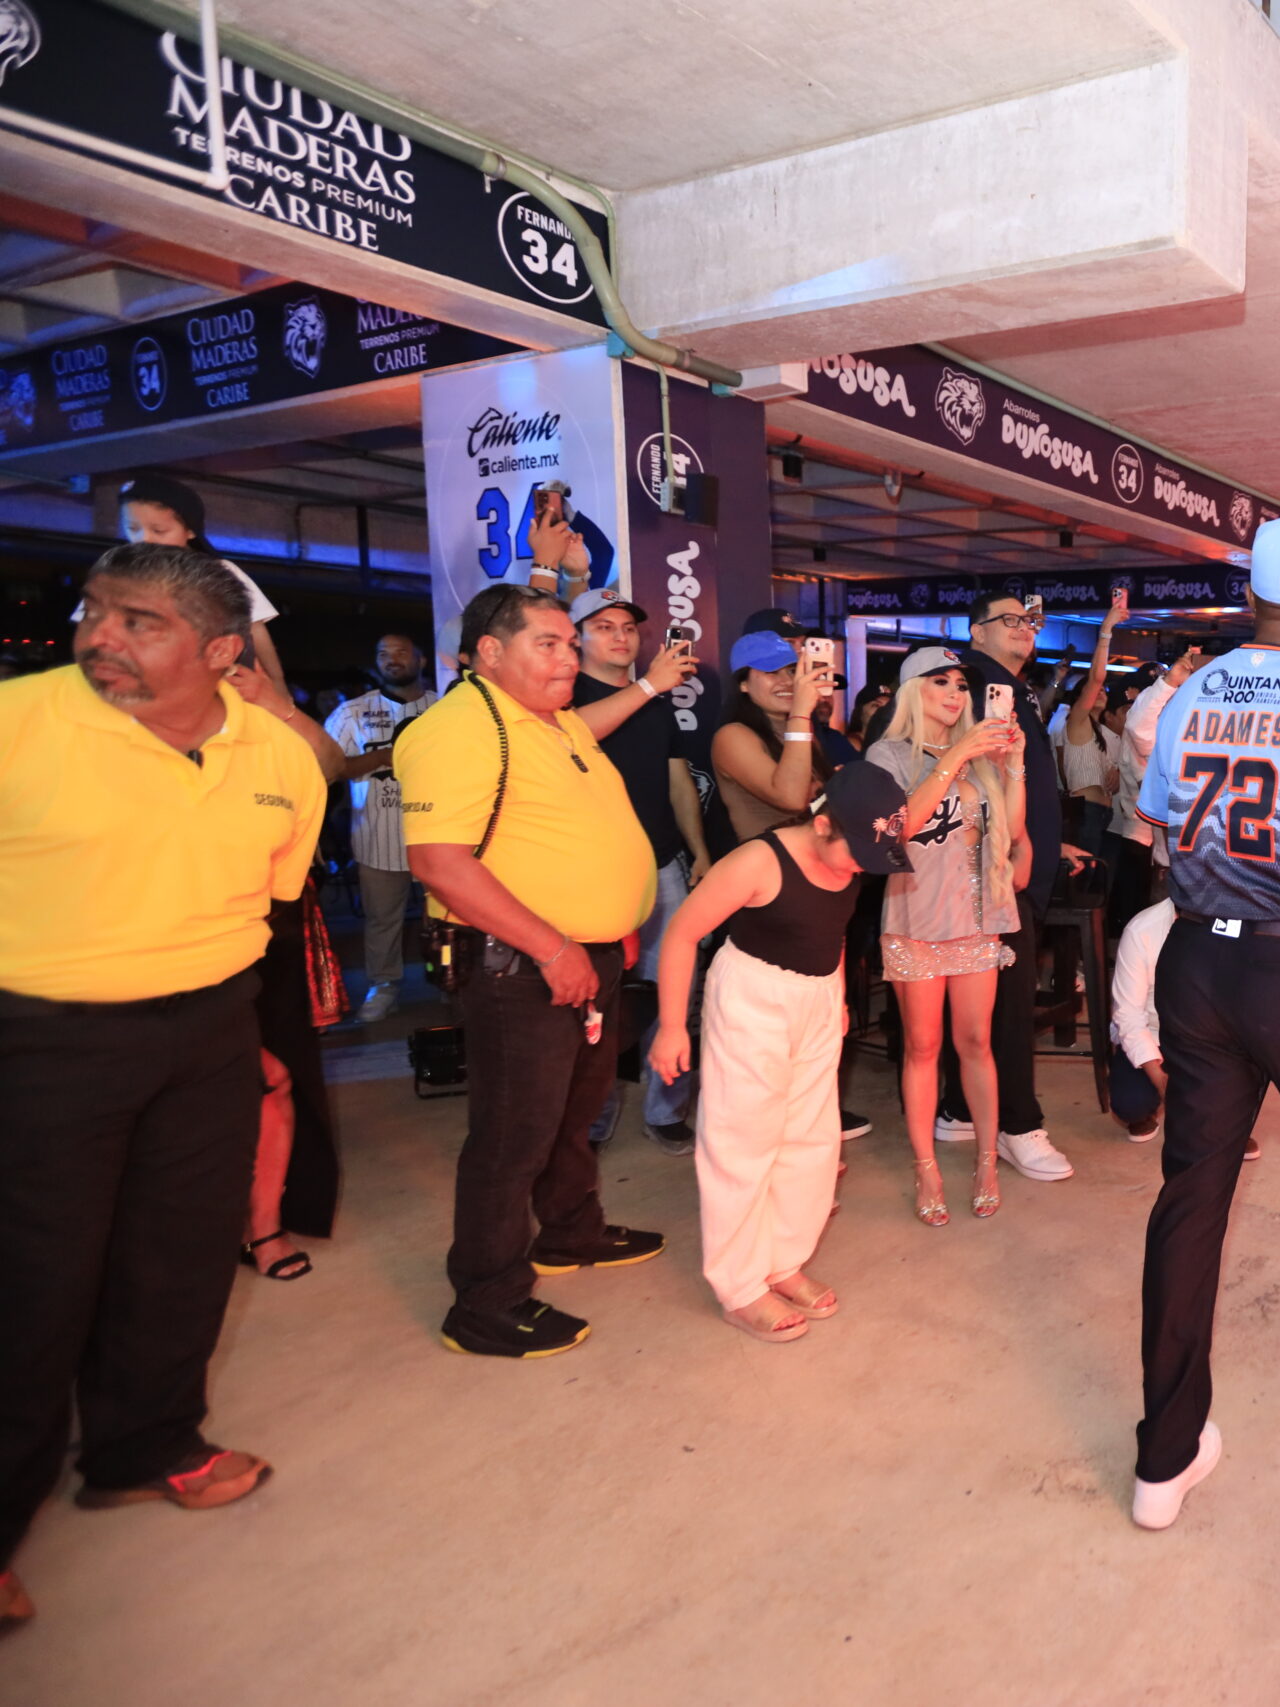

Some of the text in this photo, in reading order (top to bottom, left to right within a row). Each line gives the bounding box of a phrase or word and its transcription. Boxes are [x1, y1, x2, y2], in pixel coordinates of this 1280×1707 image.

[165, 74, 418, 205] MADERAS
[173, 126, 414, 229] TERENOS PREMIUM
[224, 173, 380, 252] CARIBE
[517, 204, 576, 242] FERNAND
[521, 228, 578, 288] 34
[186, 308, 256, 346] CIUDAD
[401, 323, 441, 340] PREMIUM
[52, 344, 108, 376] CIUDAD
[190, 336, 259, 372] MADERAS
[374, 343, 428, 373] CARIBE
[138, 364, 161, 396] 34
[206, 382, 250, 408] CARIBE
[806, 353, 916, 418] OSUSA
[1003, 399, 1041, 424] Abarrotes
[467, 406, 562, 458] Caliente
[490, 452, 560, 474] caliente.mx
[651, 443, 661, 495] FERNANDO
[1118, 464, 1138, 493] 34
[666, 540, 705, 731] DUSUSA
[1223, 690, 1255, 704] ROO
[1176, 752, 1280, 863] 72
